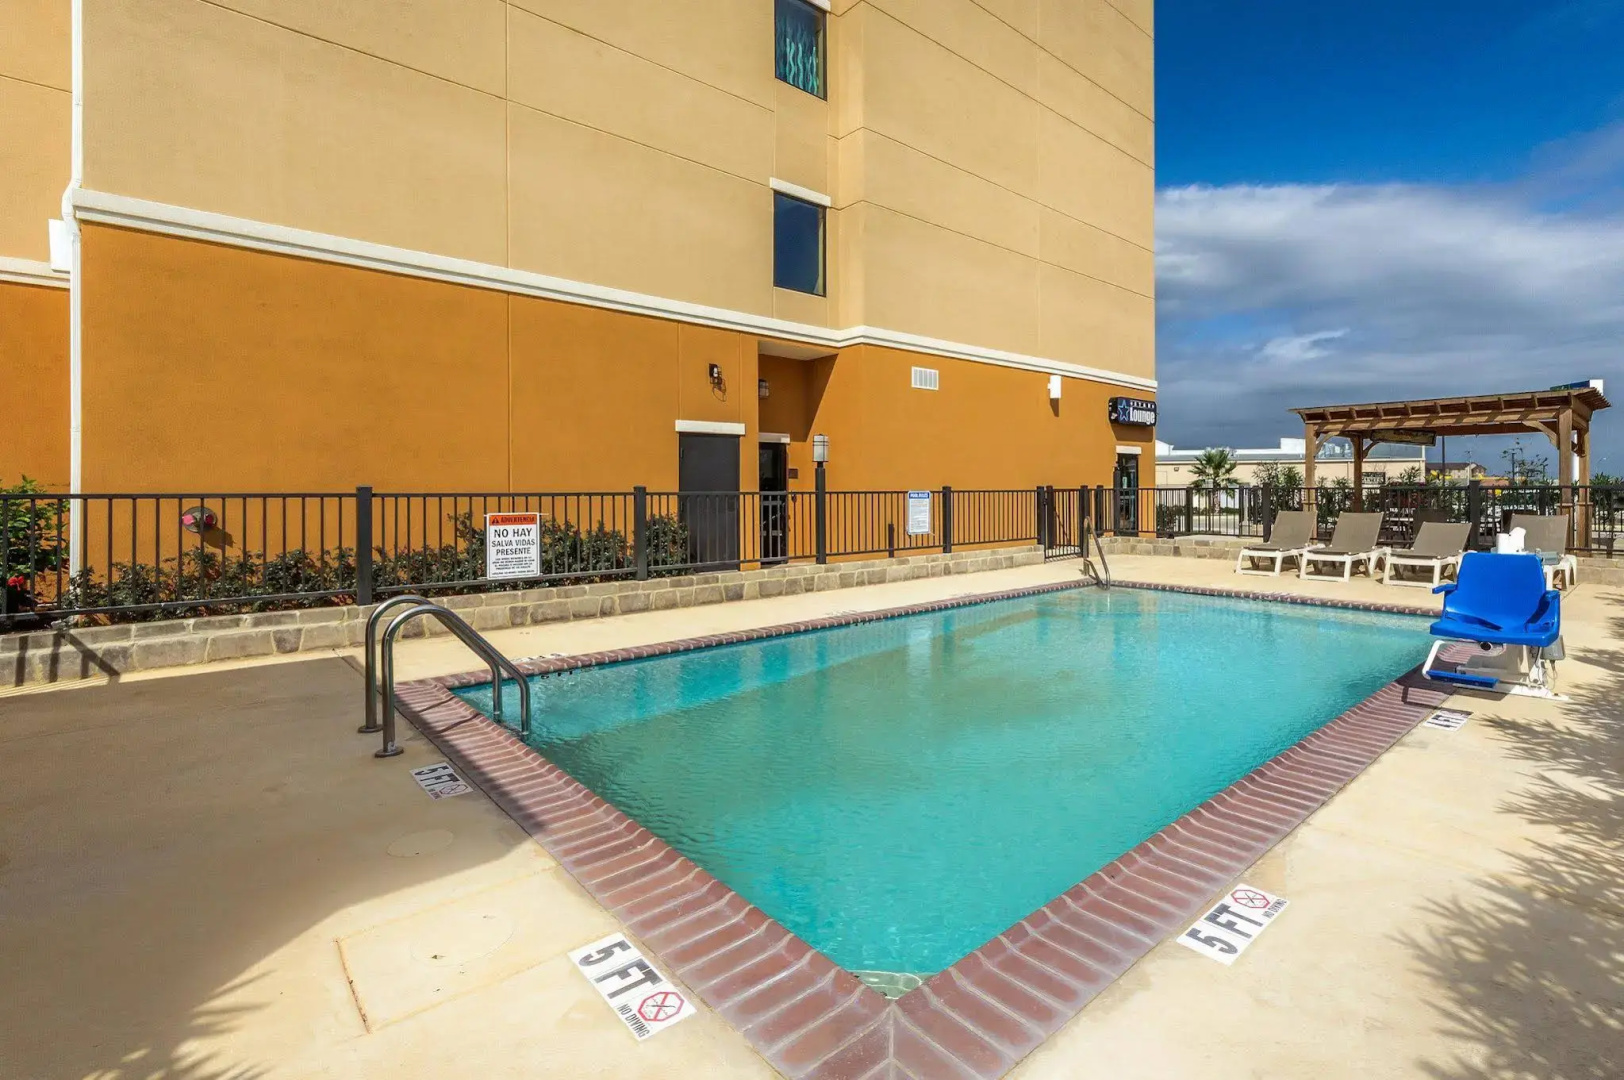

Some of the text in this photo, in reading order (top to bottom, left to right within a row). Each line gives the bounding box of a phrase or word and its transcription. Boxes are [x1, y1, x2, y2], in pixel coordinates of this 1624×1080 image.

[1130, 407, 1155, 425] Lounge
[494, 527, 532, 538] NO HAY
[515, 538, 535, 546] VIDAS
[496, 547, 531, 556] PRESENTE
[414, 765, 460, 787] 5 FT
[1185, 903, 1263, 954] 5 FT
[579, 939, 663, 999] 5 FT
[618, 1003, 650, 1037] NO DIVING
